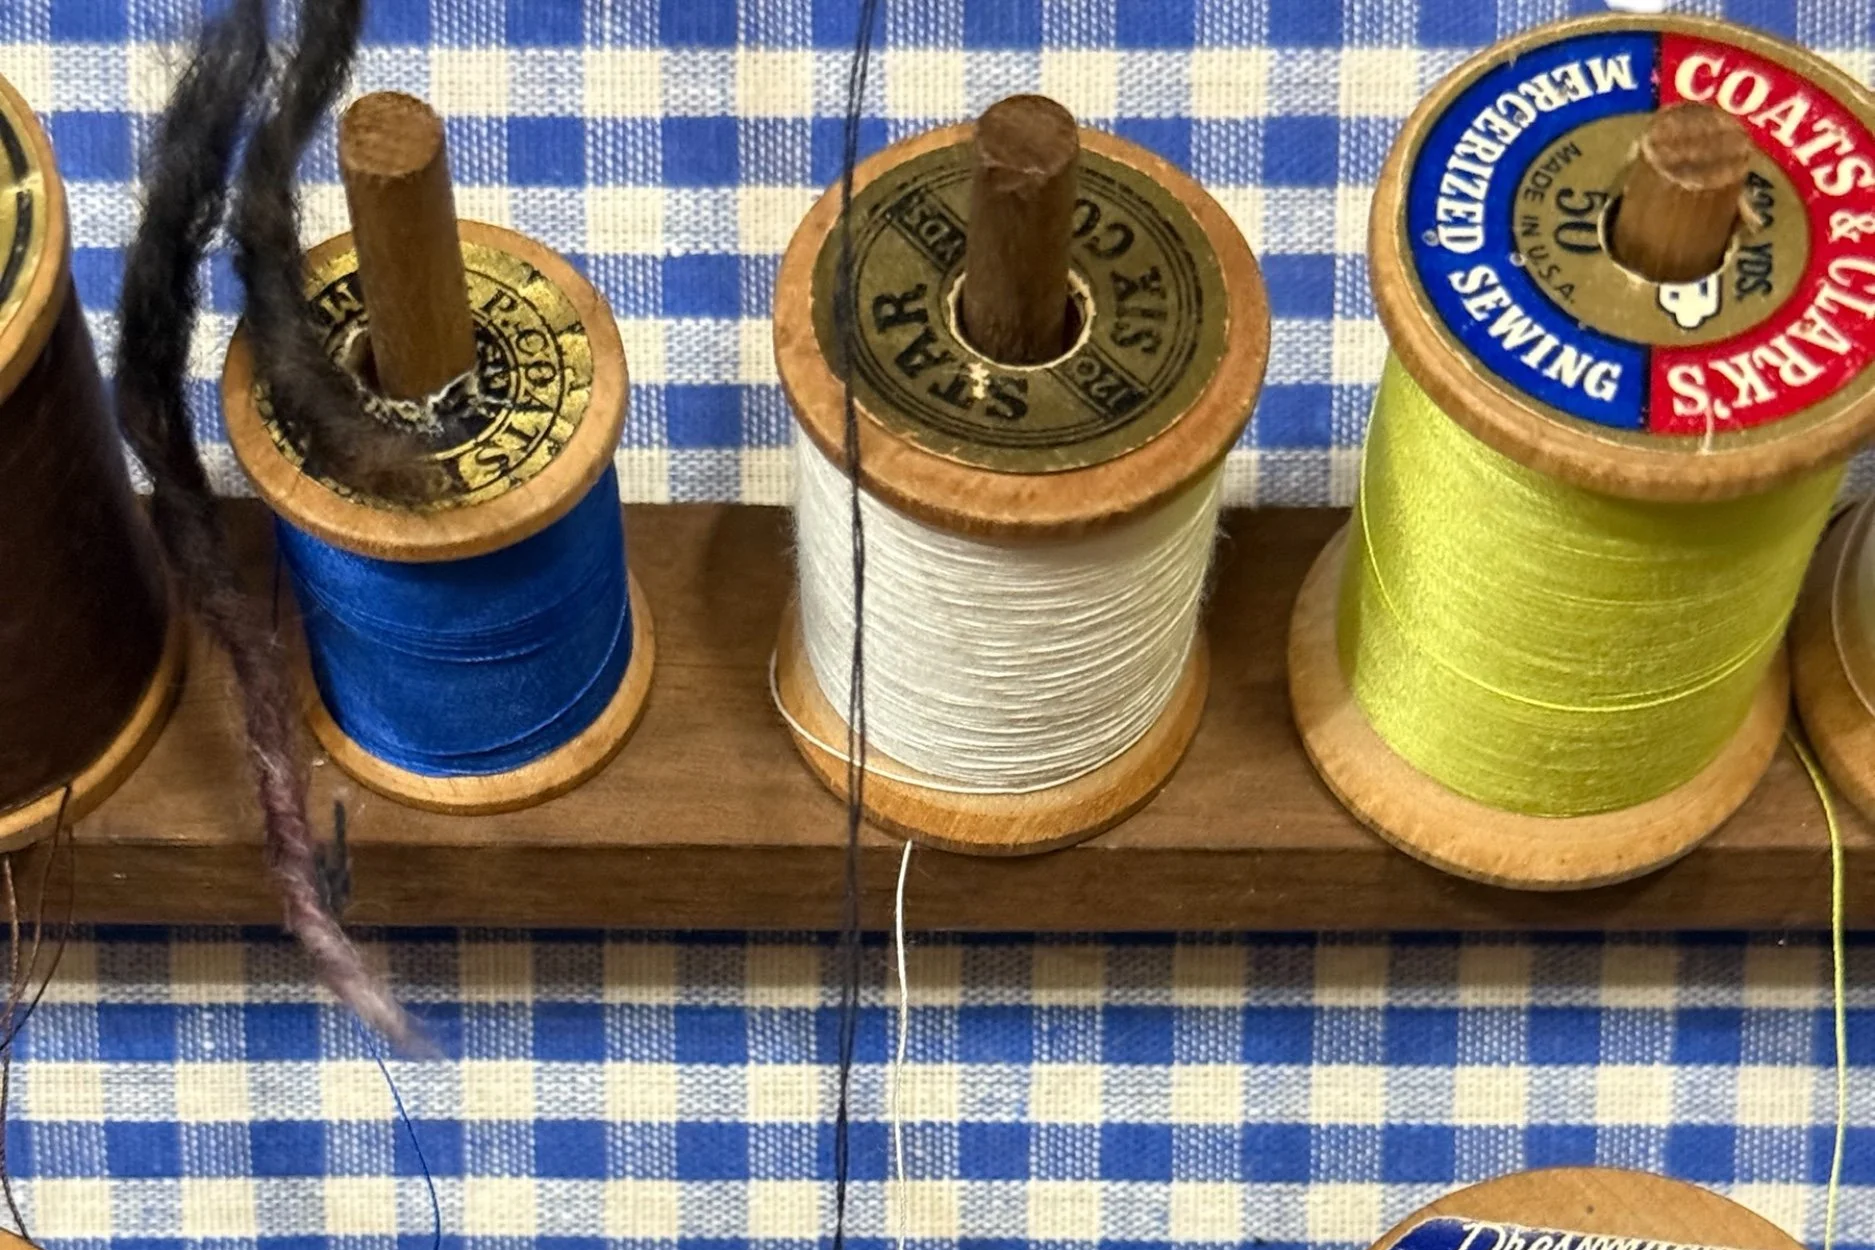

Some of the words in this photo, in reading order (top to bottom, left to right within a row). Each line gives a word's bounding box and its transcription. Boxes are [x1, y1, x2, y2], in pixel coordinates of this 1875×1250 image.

[1435, 54, 1639, 255] MERCERIZED
[1523, 141, 1582, 203] MADE
[1674, 54, 1875, 197] COATS
[1521, 214, 1541, 238] IN
[1554, 186, 1610, 255] 50
[1828, 209, 1875, 243] &
[872, 283, 1030, 421] STAR
[1109, 264, 1167, 355] SIX
[1448, 265, 1623, 403] SEWING
[1667, 255, 1875, 419] CLARK'S
